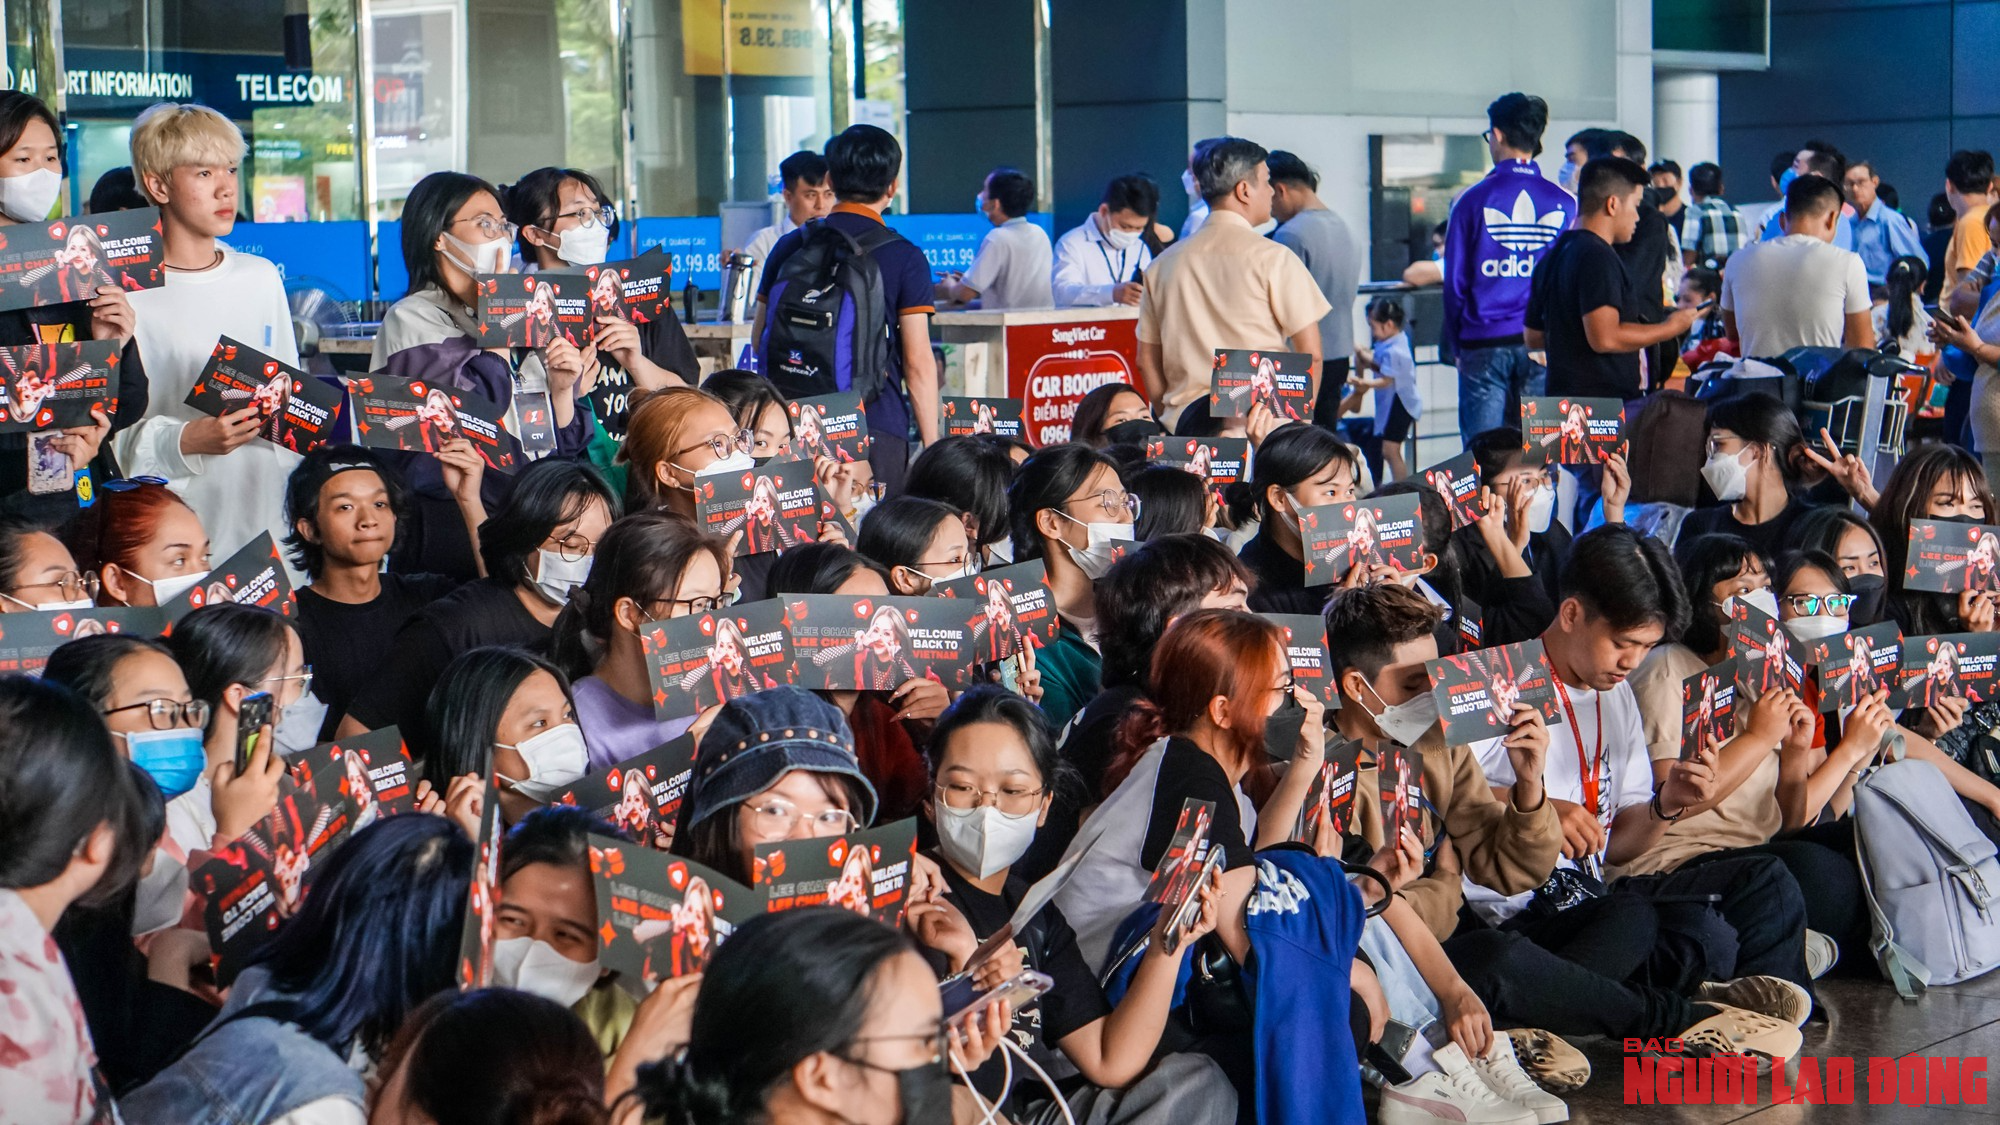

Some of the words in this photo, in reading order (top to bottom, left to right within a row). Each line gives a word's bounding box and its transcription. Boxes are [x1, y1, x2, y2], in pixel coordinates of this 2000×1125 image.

[91, 70, 192, 97] INFORMATION
[236, 74, 342, 102] TELECOM
[100, 235, 152, 250] WELCOME
[107, 248, 135, 259] BACK
[136, 246, 149, 255] TO
[108, 254, 150, 267] VIETNAM
[1481, 255, 1536, 277] adid
[621, 276, 662, 290] WELCOME
[624, 288, 646, 298] BACK
[648, 285, 659, 294] TO
[624, 293, 658, 304] VIETNAM
[554, 299, 586, 307] WELCOME
[574, 307, 584, 315] TO
[1052, 326, 1090, 346] SongViet
[1090, 326, 1106, 341] Car
[1276, 374, 1306, 383] WELCOME
[1032, 375, 1061, 398] CAR
[1278, 382, 1295, 390] BACK
[1295, 382, 1304, 390] TO
[289, 396, 330, 420] WELCOME
[604, 393, 625, 417] YO
[287, 406, 310, 421] BACK
[310, 415, 322, 426] TO
[456, 410, 498, 432] WELCOME
[822, 414, 858, 426] WELCOME
[284, 414, 320, 434] VIETNAM
[461, 420, 484, 435] BACK
[484, 428, 496, 439] TO
[826, 424, 845, 434] BACK
[846, 422, 856, 431] TO
[994, 420, 1019, 428] WELCOME
[1587, 420, 1618, 428] WELCOME
[826, 430, 858, 441] VIETNAM
[996, 428, 1008, 436] BACK
[1008, 428, 1017, 436] TO
[1451, 474, 1476, 490] WELCOME
[1455, 486, 1468, 496] BACK
[1468, 482, 1475, 491] TO
[777, 487, 814, 501] WELCOME
[782, 500, 803, 510] BACK
[803, 497, 813, 506] TO
[782, 508, 815, 519] VIETNAM
[1376, 519, 1414, 532] WELCOME
[1380, 530, 1400, 541] BACK
[1401, 528, 1411, 538] TO
[1380, 538, 1412, 548] VIETNAM
[232, 566, 276, 602] WELCOME
[264, 579, 275, 592] TO
[1010, 589, 1046, 605] WELCOME
[1016, 602, 1036, 614] BACK
[1036, 599, 1046, 608] TO
[742, 630, 783, 647] WELCOME
[792, 626, 818, 637] LEE
[908, 629, 963, 640] WELCOME
[749, 644, 771, 657] BACK
[771, 642, 782, 652] TO
[912, 639, 943, 650] BACK
[945, 640, 958, 650] TO
[1870, 644, 1899, 659] WELCOME
[794, 648, 818, 658] LEE
[912, 650, 958, 660] VIETNAM
[1286, 647, 1322, 657] WELCOME
[750, 652, 784, 668] VIETNAM
[1291, 658, 1310, 667] BACK
[1311, 658, 1320, 667] TO
[1785, 653, 1803, 677] WELCOME
[1873, 656, 1888, 667] BACK
[1888, 653, 1896, 662] TO
[1958, 654, 1997, 665] WELCOME
[1786, 662, 1797, 680] BACK
[1960, 664, 1980, 673] BACK
[1982, 662, 1993, 671] TO
[1959, 671, 1992, 680] VIETNAM
[1451, 693, 1467, 704] TO
[1468, 690, 1486, 702] BACK
[1714, 686, 1734, 700] WELCOME
[1450, 699, 1492, 716] WELCOME
[1714, 699, 1726, 709] BACK
[1726, 697, 1732, 706] TO
[369, 760, 406, 780] WELCOME
[375, 780, 395, 792] BACK
[395, 774, 406, 787] TO
[1332, 770, 1355, 790] WELCOME
[656, 788, 682, 806] BACK
[1332, 785, 1346, 799] BACK
[872, 861, 908, 883] WELCOME
[874, 879, 894, 896] BACK
